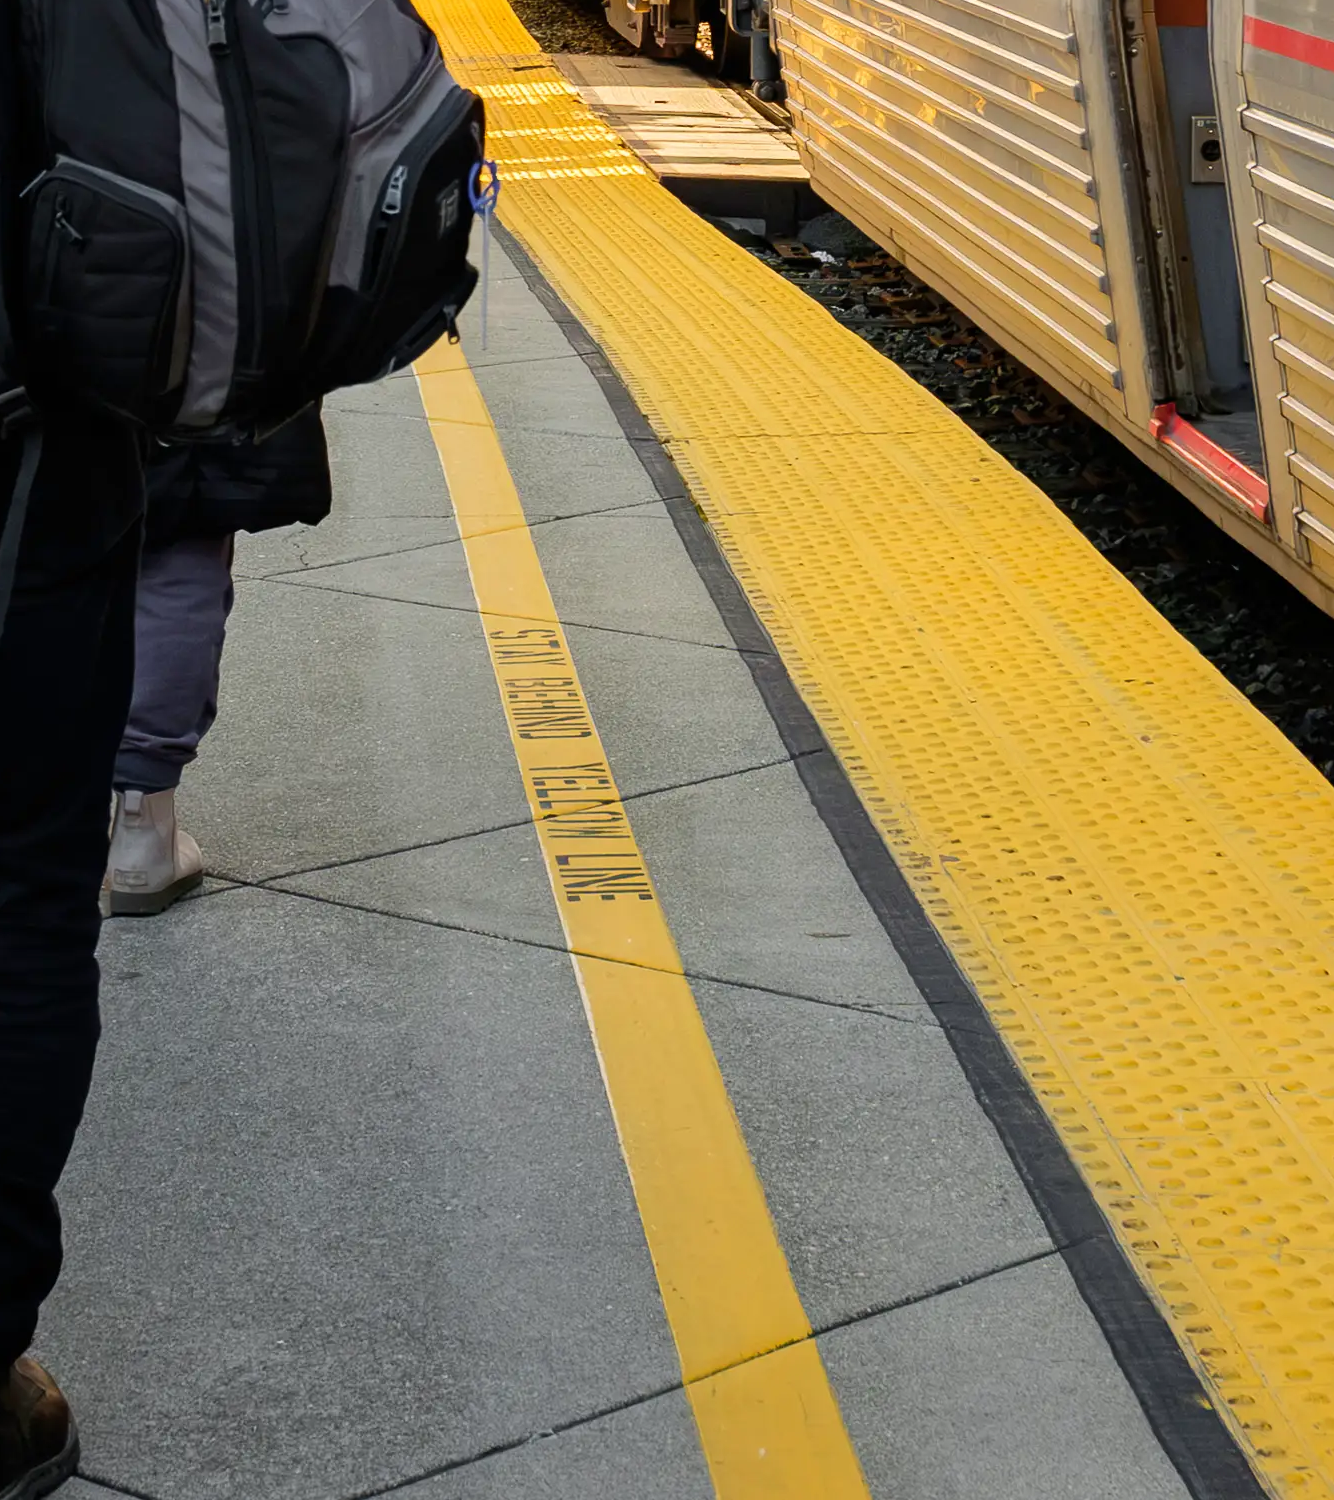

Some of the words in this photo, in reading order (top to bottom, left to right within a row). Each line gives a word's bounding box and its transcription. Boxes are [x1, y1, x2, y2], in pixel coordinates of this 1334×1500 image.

[489, 629, 567, 666] STAY
[503, 676, 593, 739] BEHIND
[528, 762, 631, 839] YELLOW
[555, 852, 654, 902] LINE
